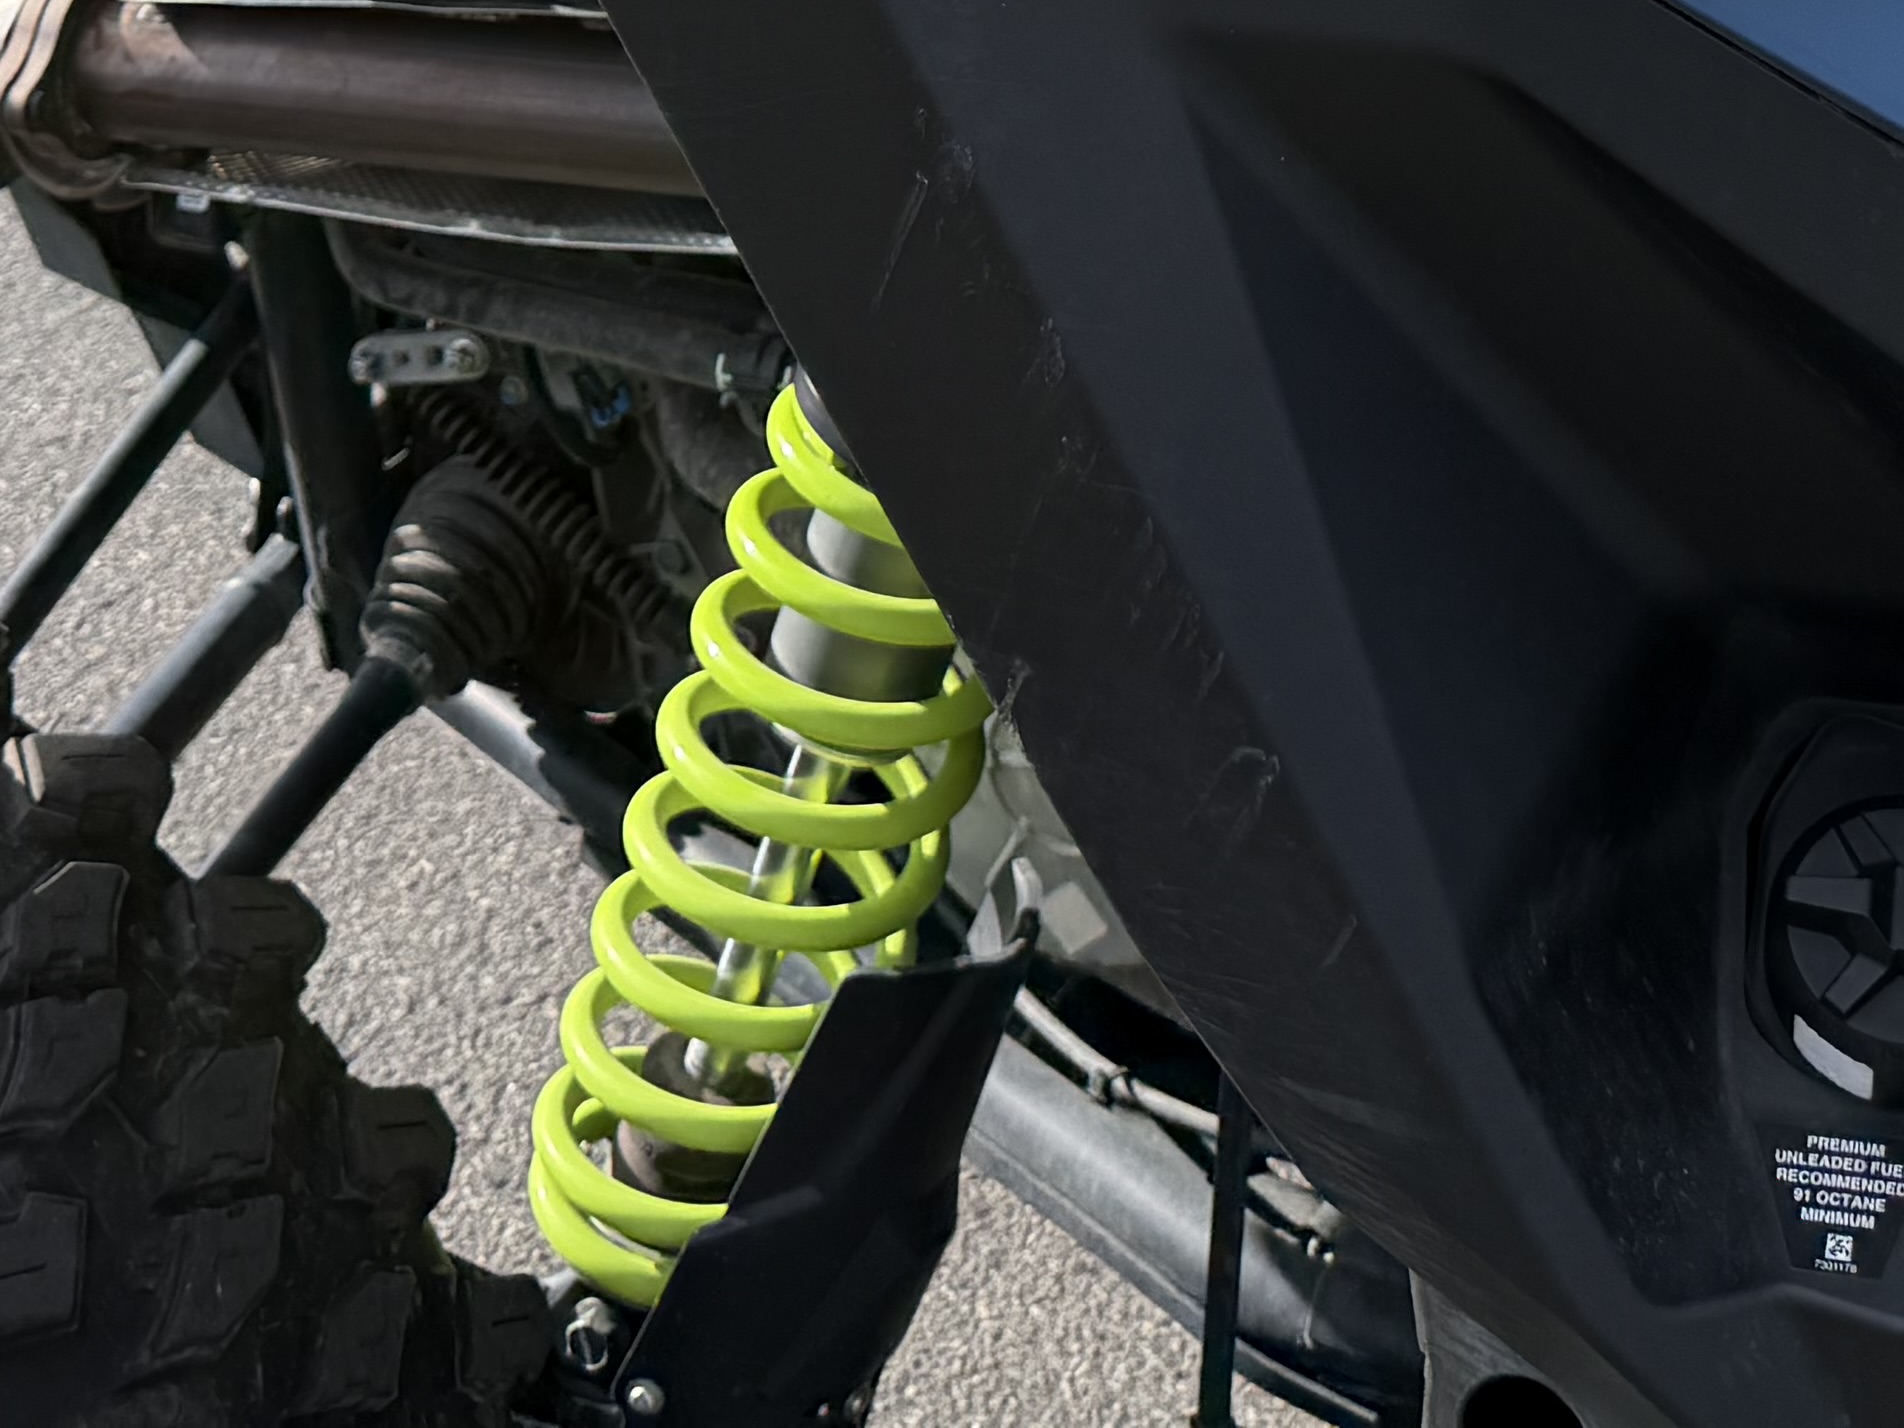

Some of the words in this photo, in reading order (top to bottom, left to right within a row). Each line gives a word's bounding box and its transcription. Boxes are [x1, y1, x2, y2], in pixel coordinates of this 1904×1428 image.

[1806, 1135, 1886, 1157] PREMIUM
[1775, 1148, 1867, 1172] UNLEADED
[1793, 1187, 1811, 1202] 91
[1816, 1190, 1886, 1212] OCTANE
[1800, 1206, 1875, 1229] MINIMUM
